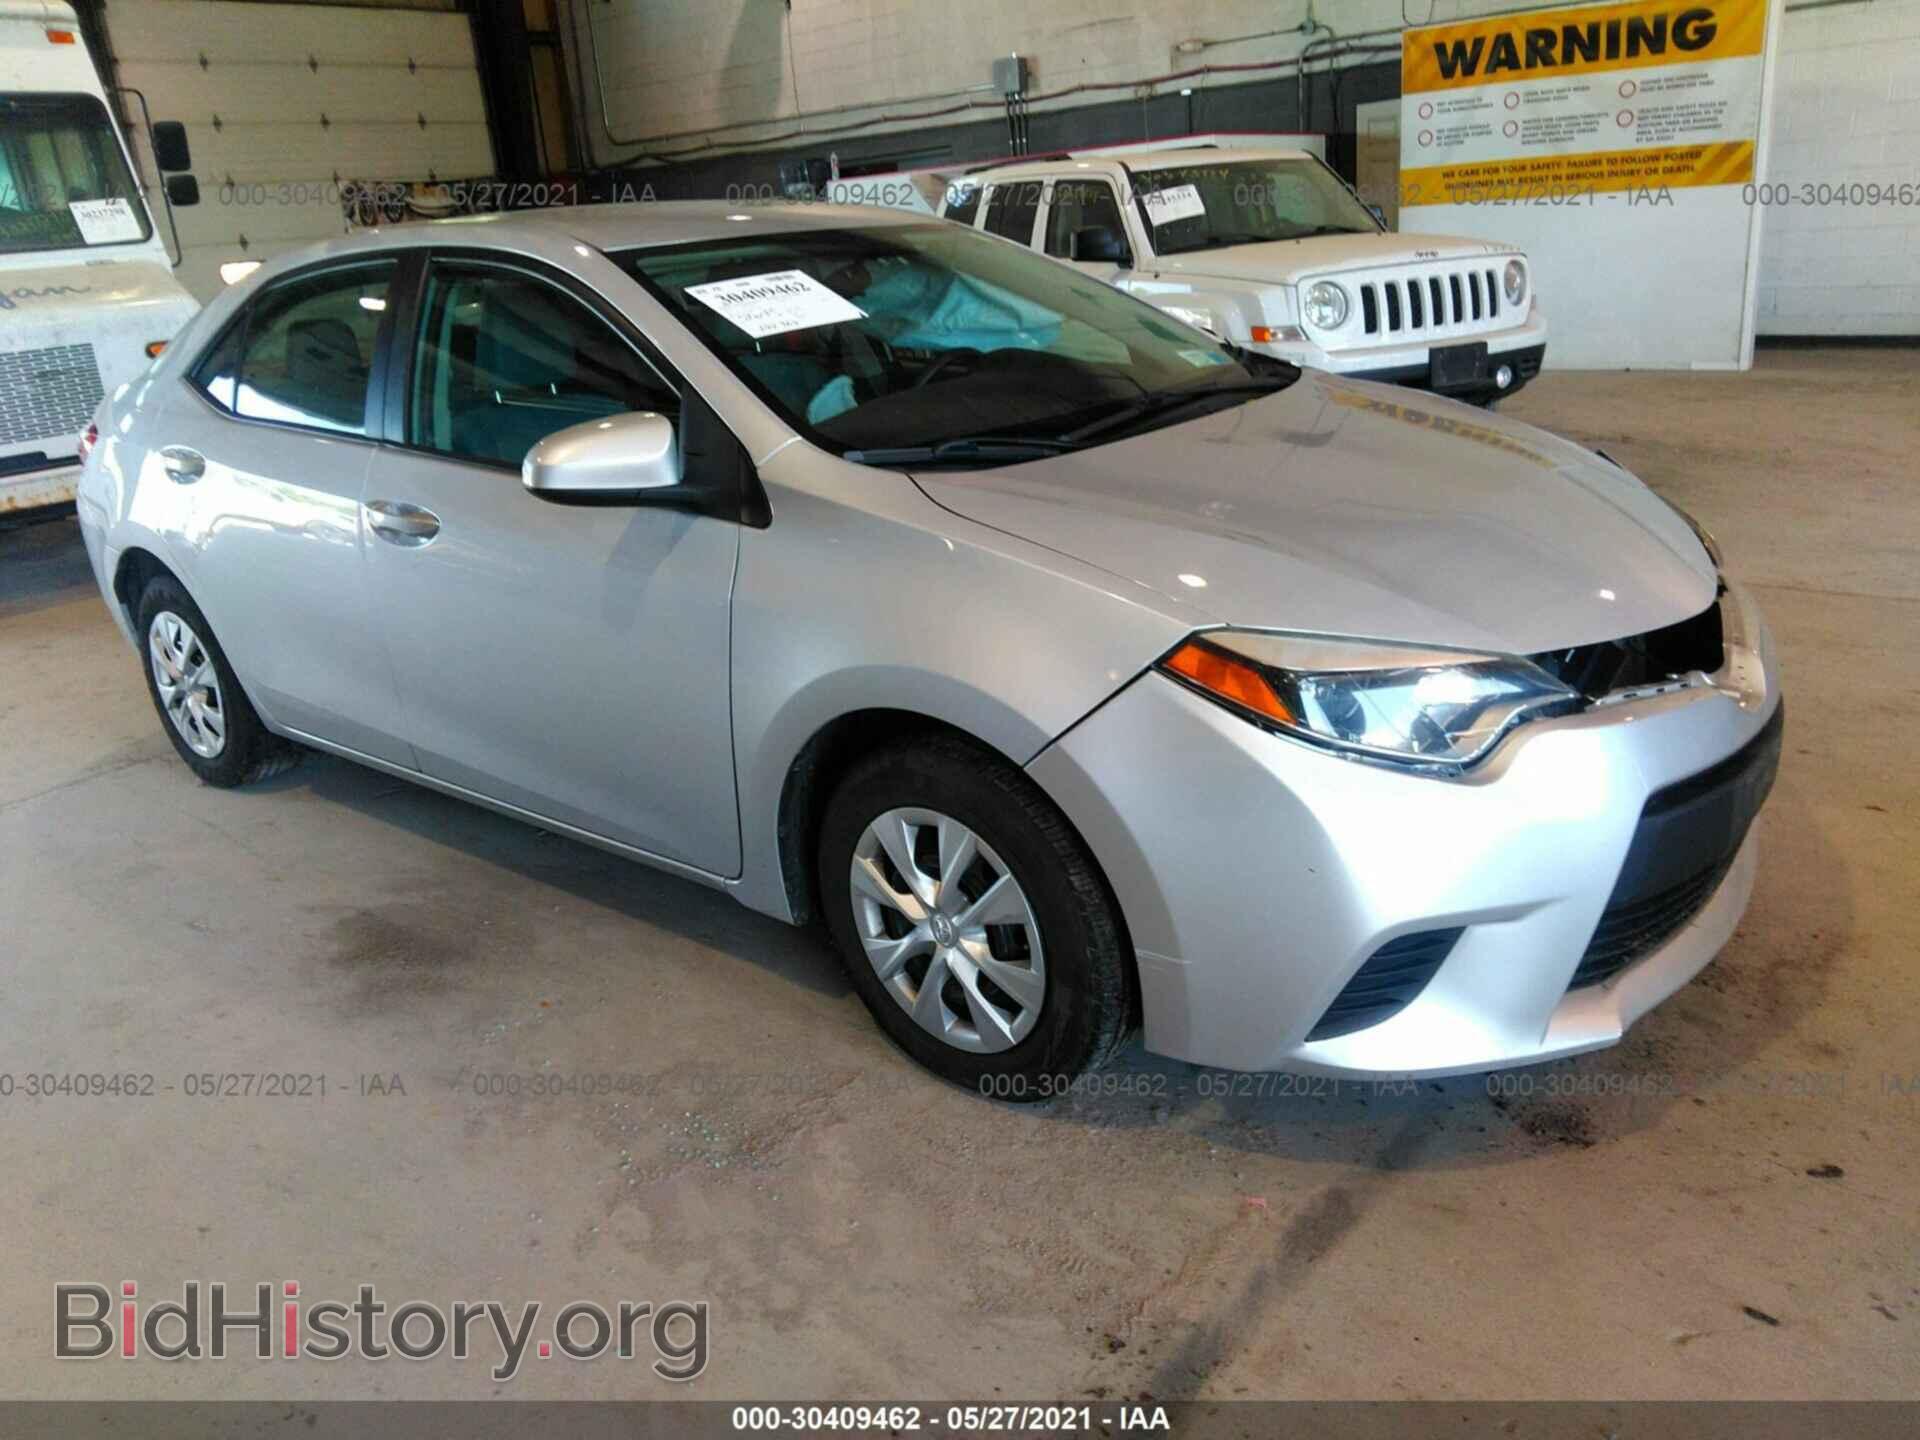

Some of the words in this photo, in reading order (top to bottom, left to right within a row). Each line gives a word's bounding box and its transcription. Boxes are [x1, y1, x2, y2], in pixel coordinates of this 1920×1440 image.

[1434, 8, 1718, 80] WARNING
[1483, 166, 1500, 175] FOR
[1503, 165, 1527, 173] YOUR
[1606, 156, 1617, 165] TO
[1620, 154, 1660, 165] FOLLOW
[1664, 151, 1702, 160] POSTED
[1645, 166, 1659, 176] OR
[714, 280, 811, 306] 30409462
